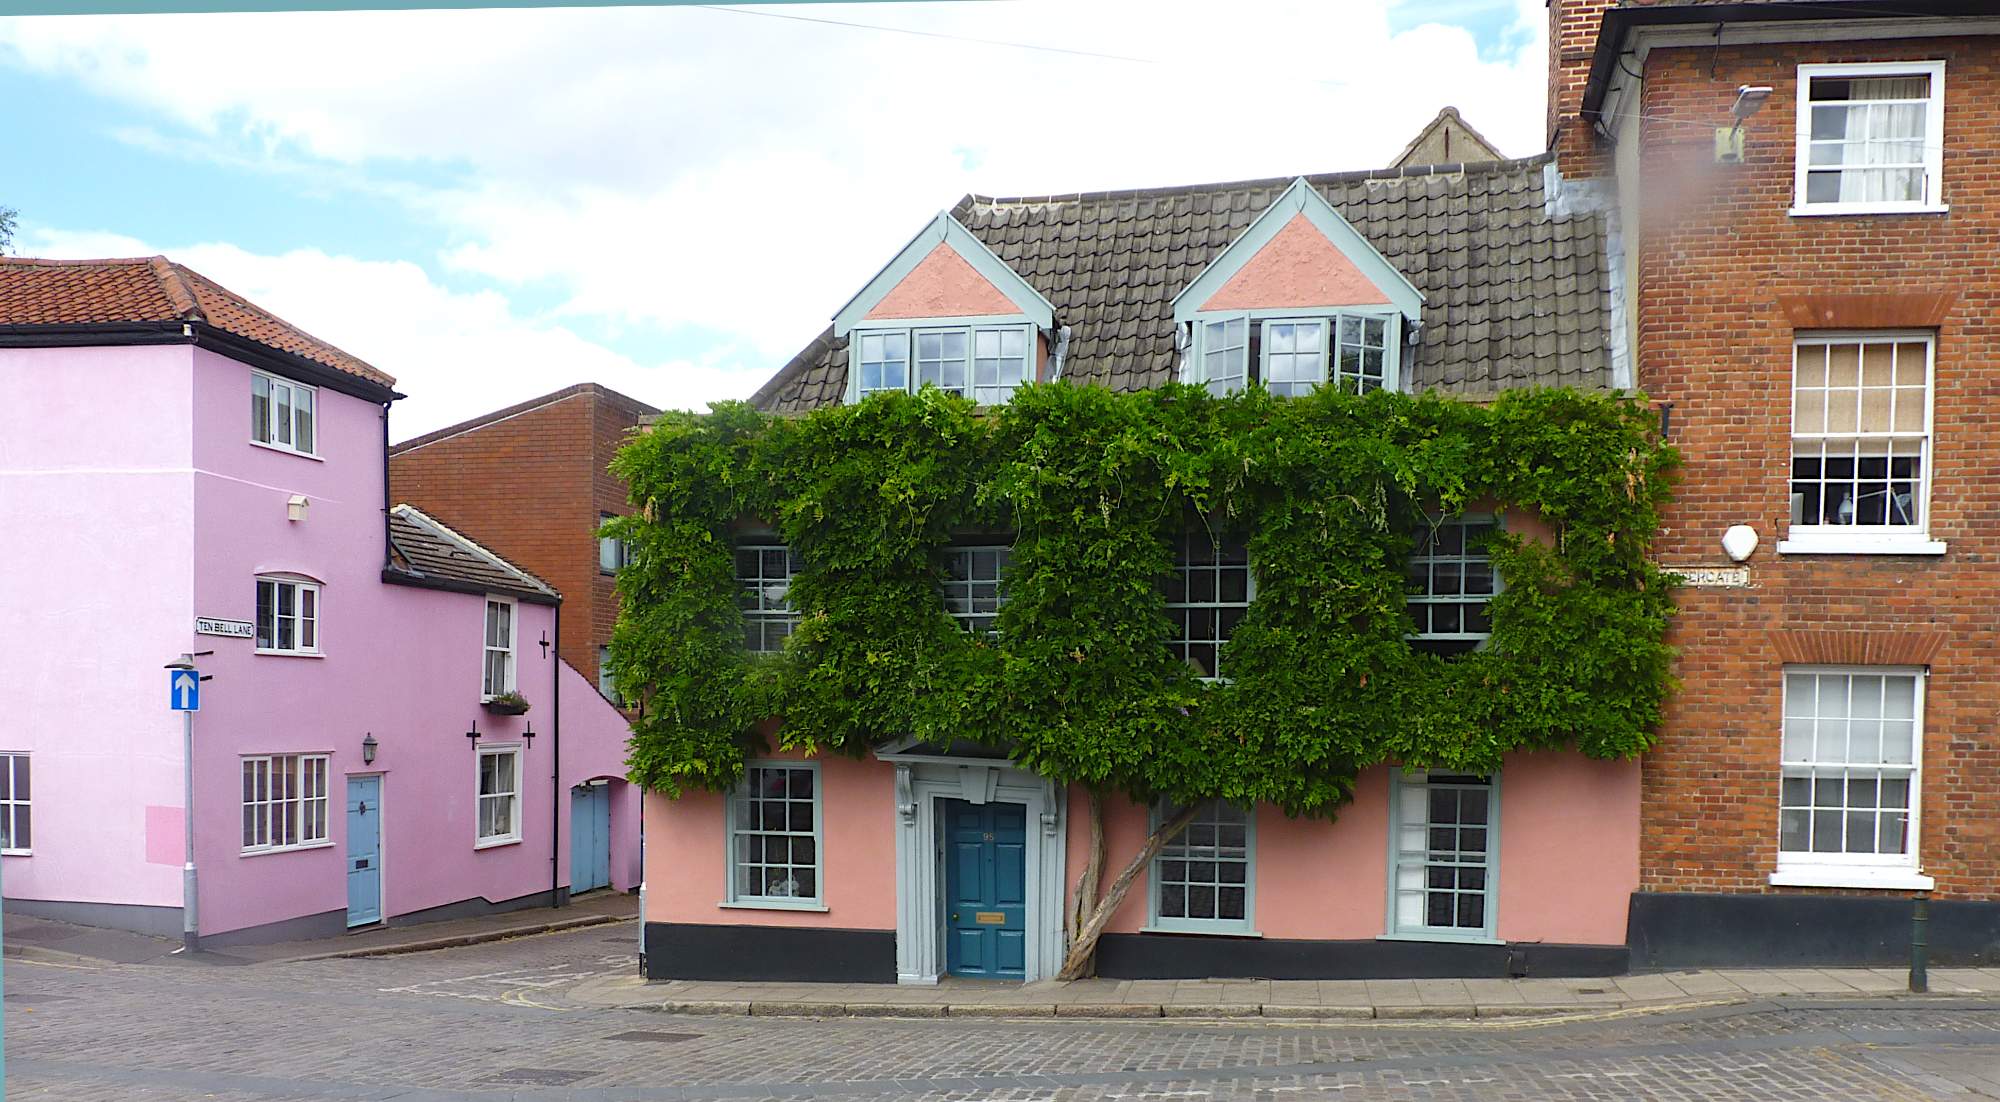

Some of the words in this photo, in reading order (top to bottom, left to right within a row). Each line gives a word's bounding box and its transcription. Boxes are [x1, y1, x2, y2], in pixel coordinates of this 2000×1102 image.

[1670, 571, 1740, 583] ERGATE
[198, 621, 213, 632] TEN
[214, 622, 232, 633] BELL
[234, 624, 251, 635] LANE
[983, 832, 994, 841] 95
